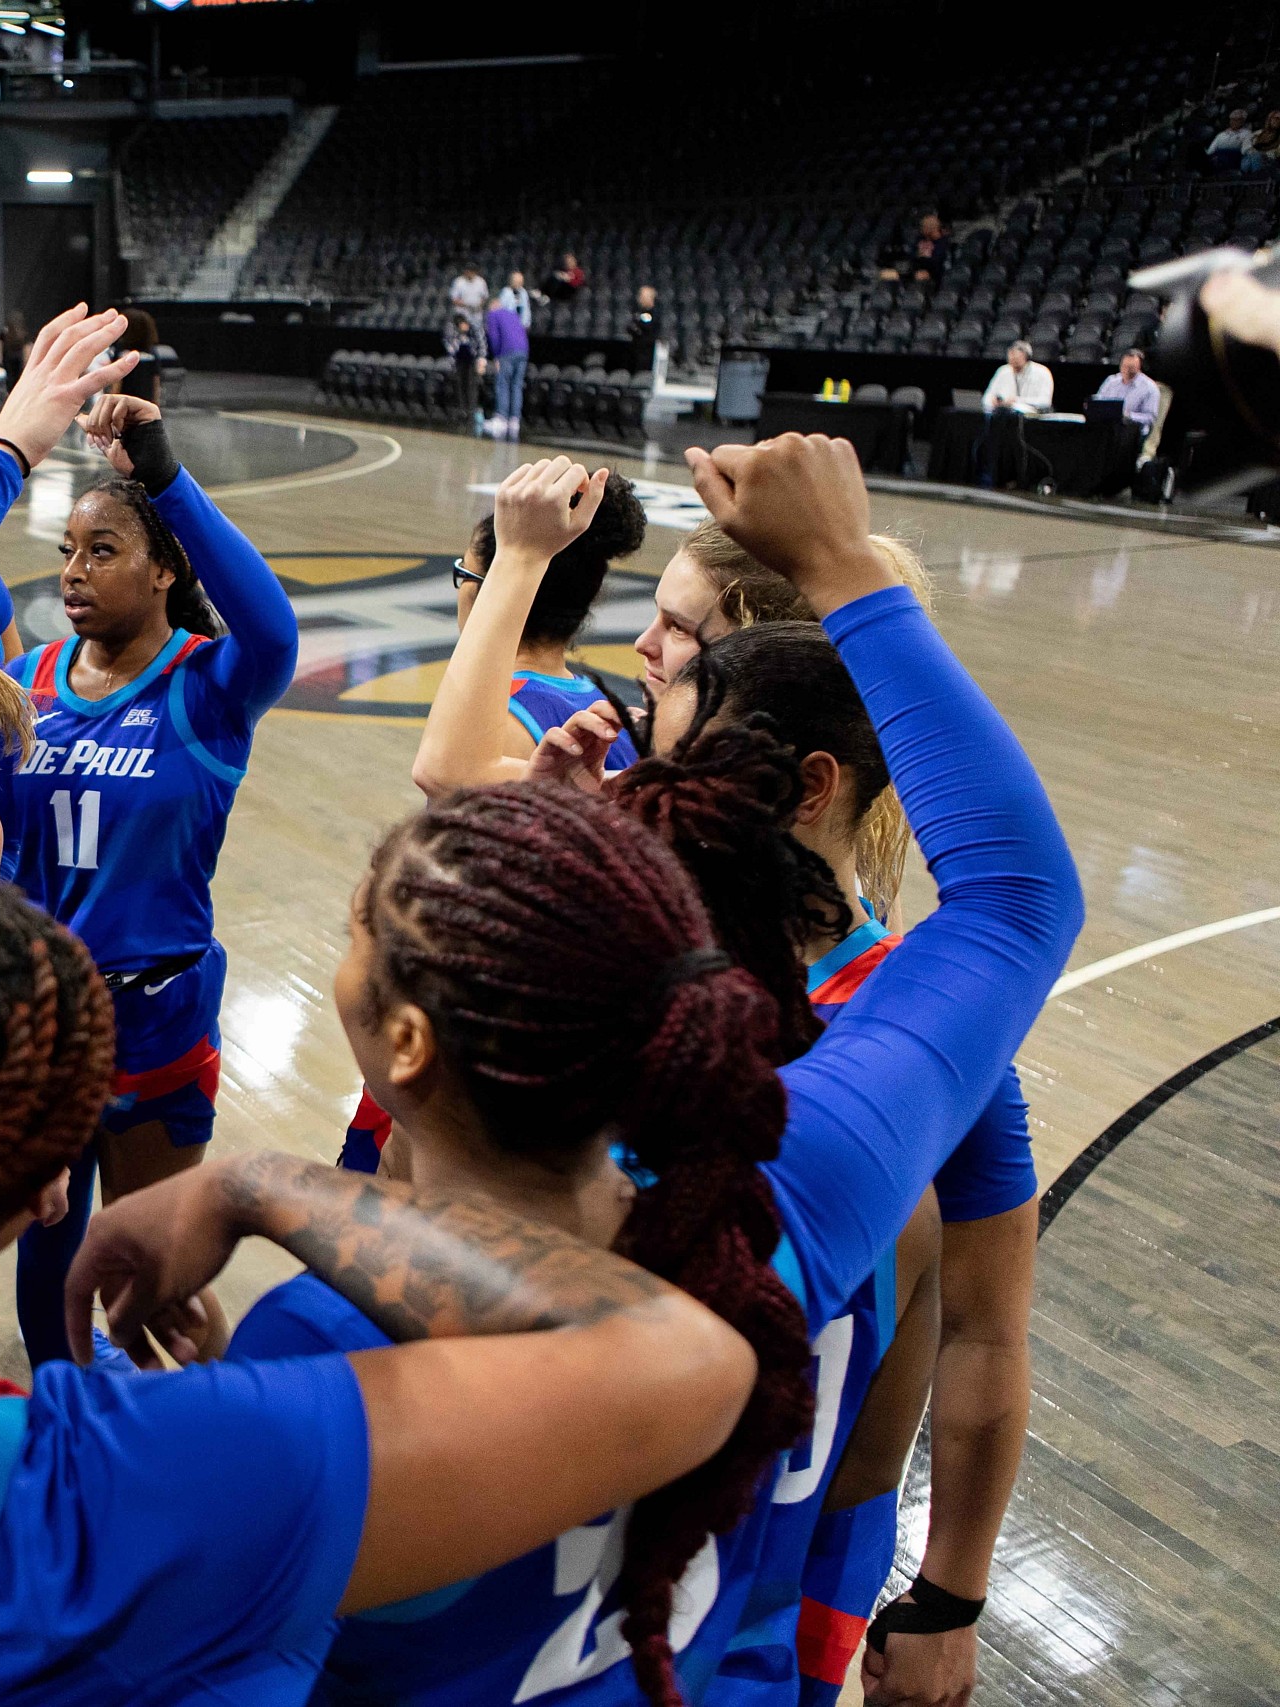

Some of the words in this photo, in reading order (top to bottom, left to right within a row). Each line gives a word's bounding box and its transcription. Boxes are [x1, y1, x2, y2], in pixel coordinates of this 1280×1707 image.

[127, 708, 153, 718] BIG
[123, 716, 159, 725] EAST
[49, 790, 101, 869] 11
